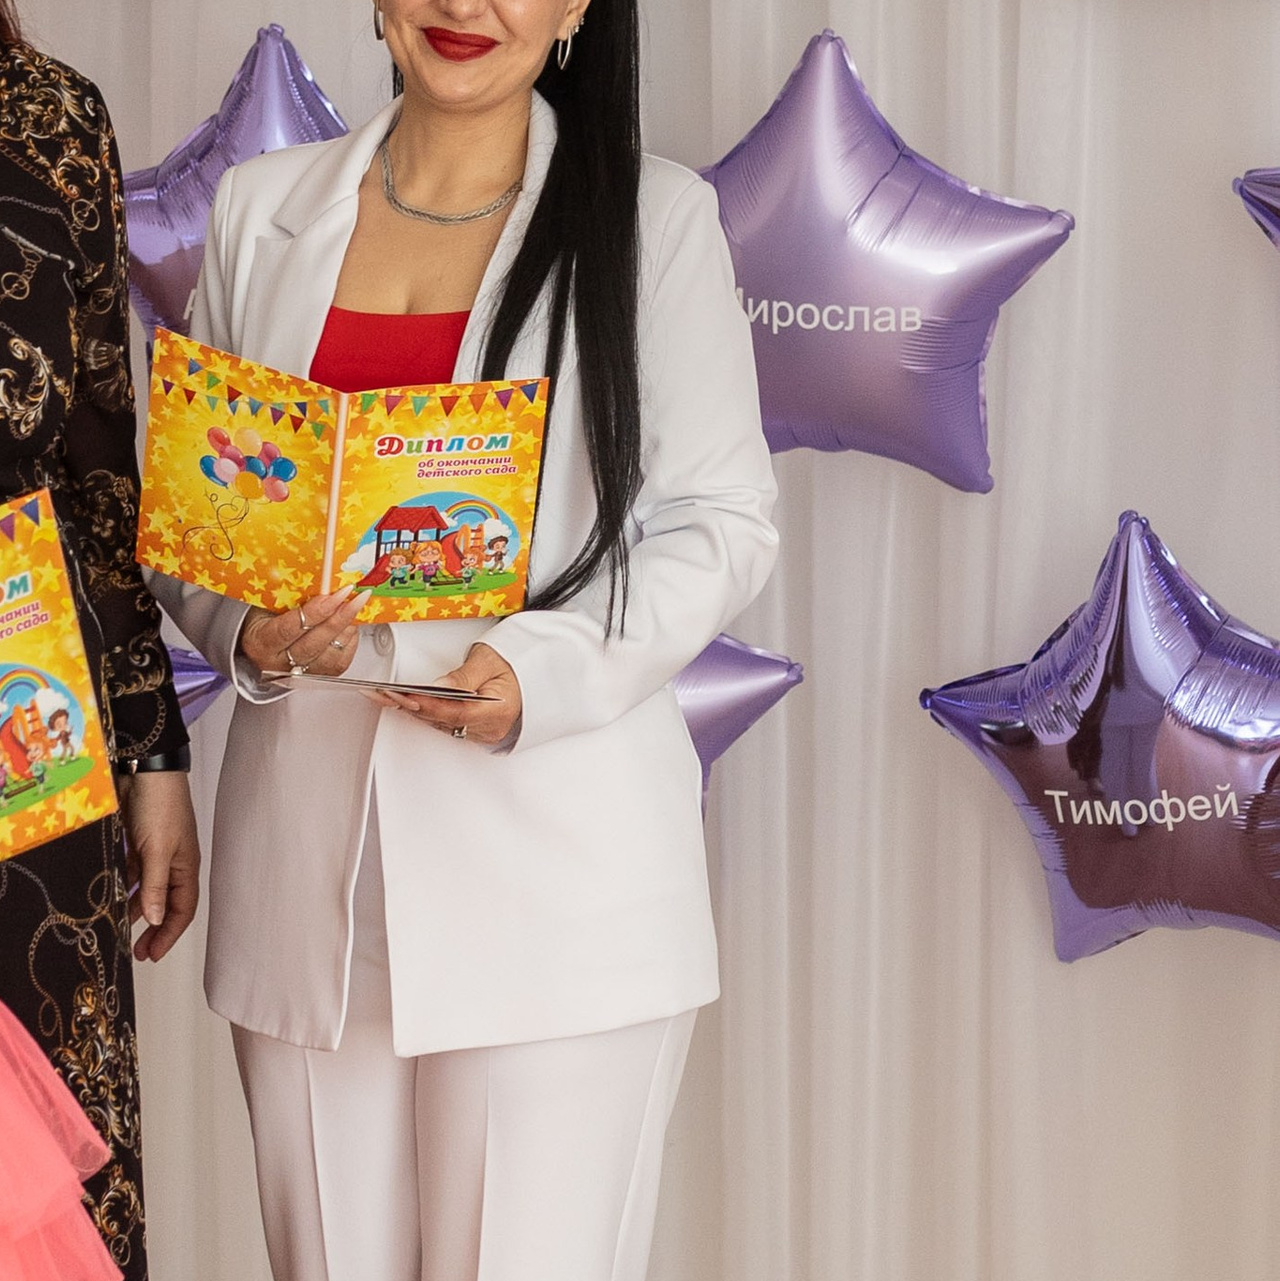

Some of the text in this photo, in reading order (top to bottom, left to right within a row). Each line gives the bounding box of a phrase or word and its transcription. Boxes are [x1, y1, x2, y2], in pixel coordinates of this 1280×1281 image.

[736, 287, 922, 335] ирослав
[376, 433, 511, 457] Диплом
[417, 464, 517, 478] детского сада
[418, 456, 512, 469] об окончании
[15, 611, 49, 632] сада
[1043, 783, 1239, 832] Тимофей
